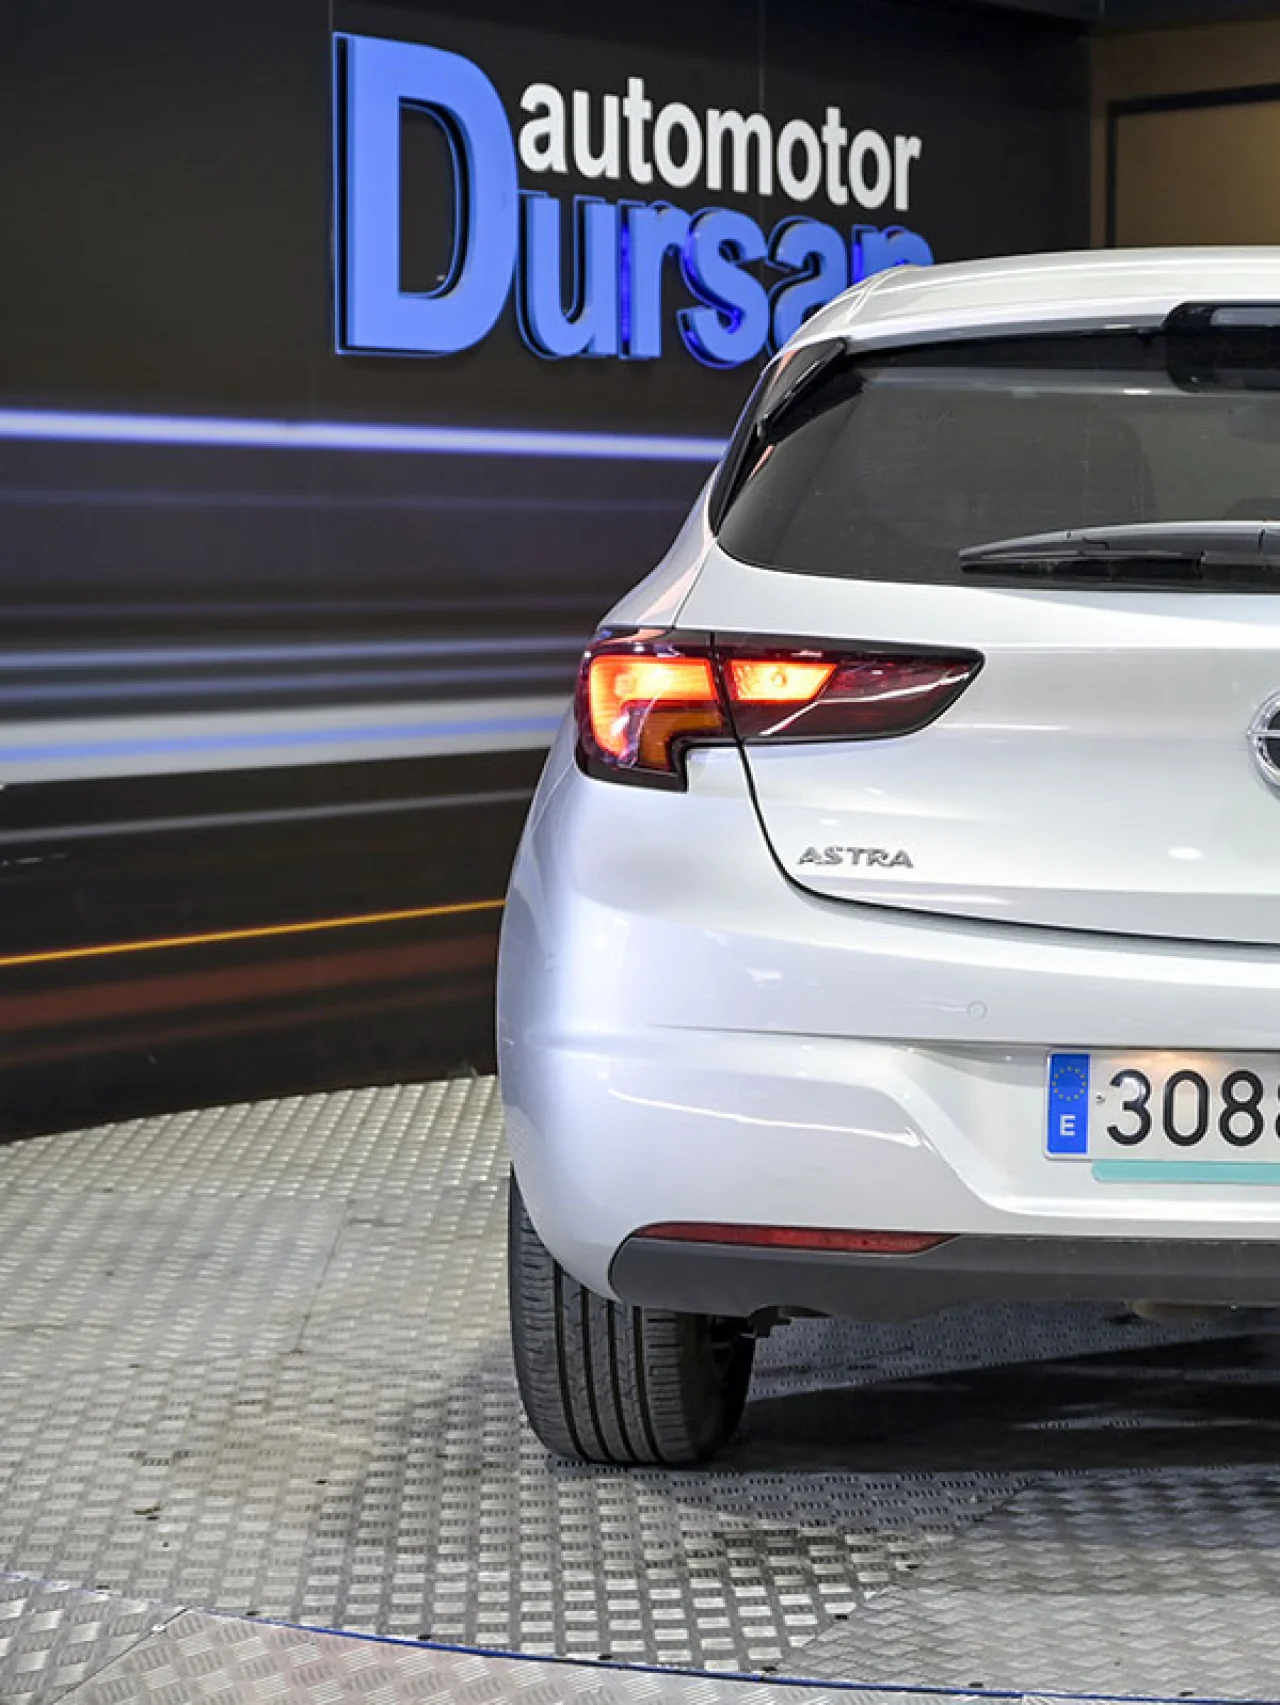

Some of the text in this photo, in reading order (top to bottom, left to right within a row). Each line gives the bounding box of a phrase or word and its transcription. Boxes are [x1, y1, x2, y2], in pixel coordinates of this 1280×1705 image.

[518, 77, 922, 211] automotor
[798, 847, 914, 868] ASTRA
[1059, 1114, 1076, 1136] E
